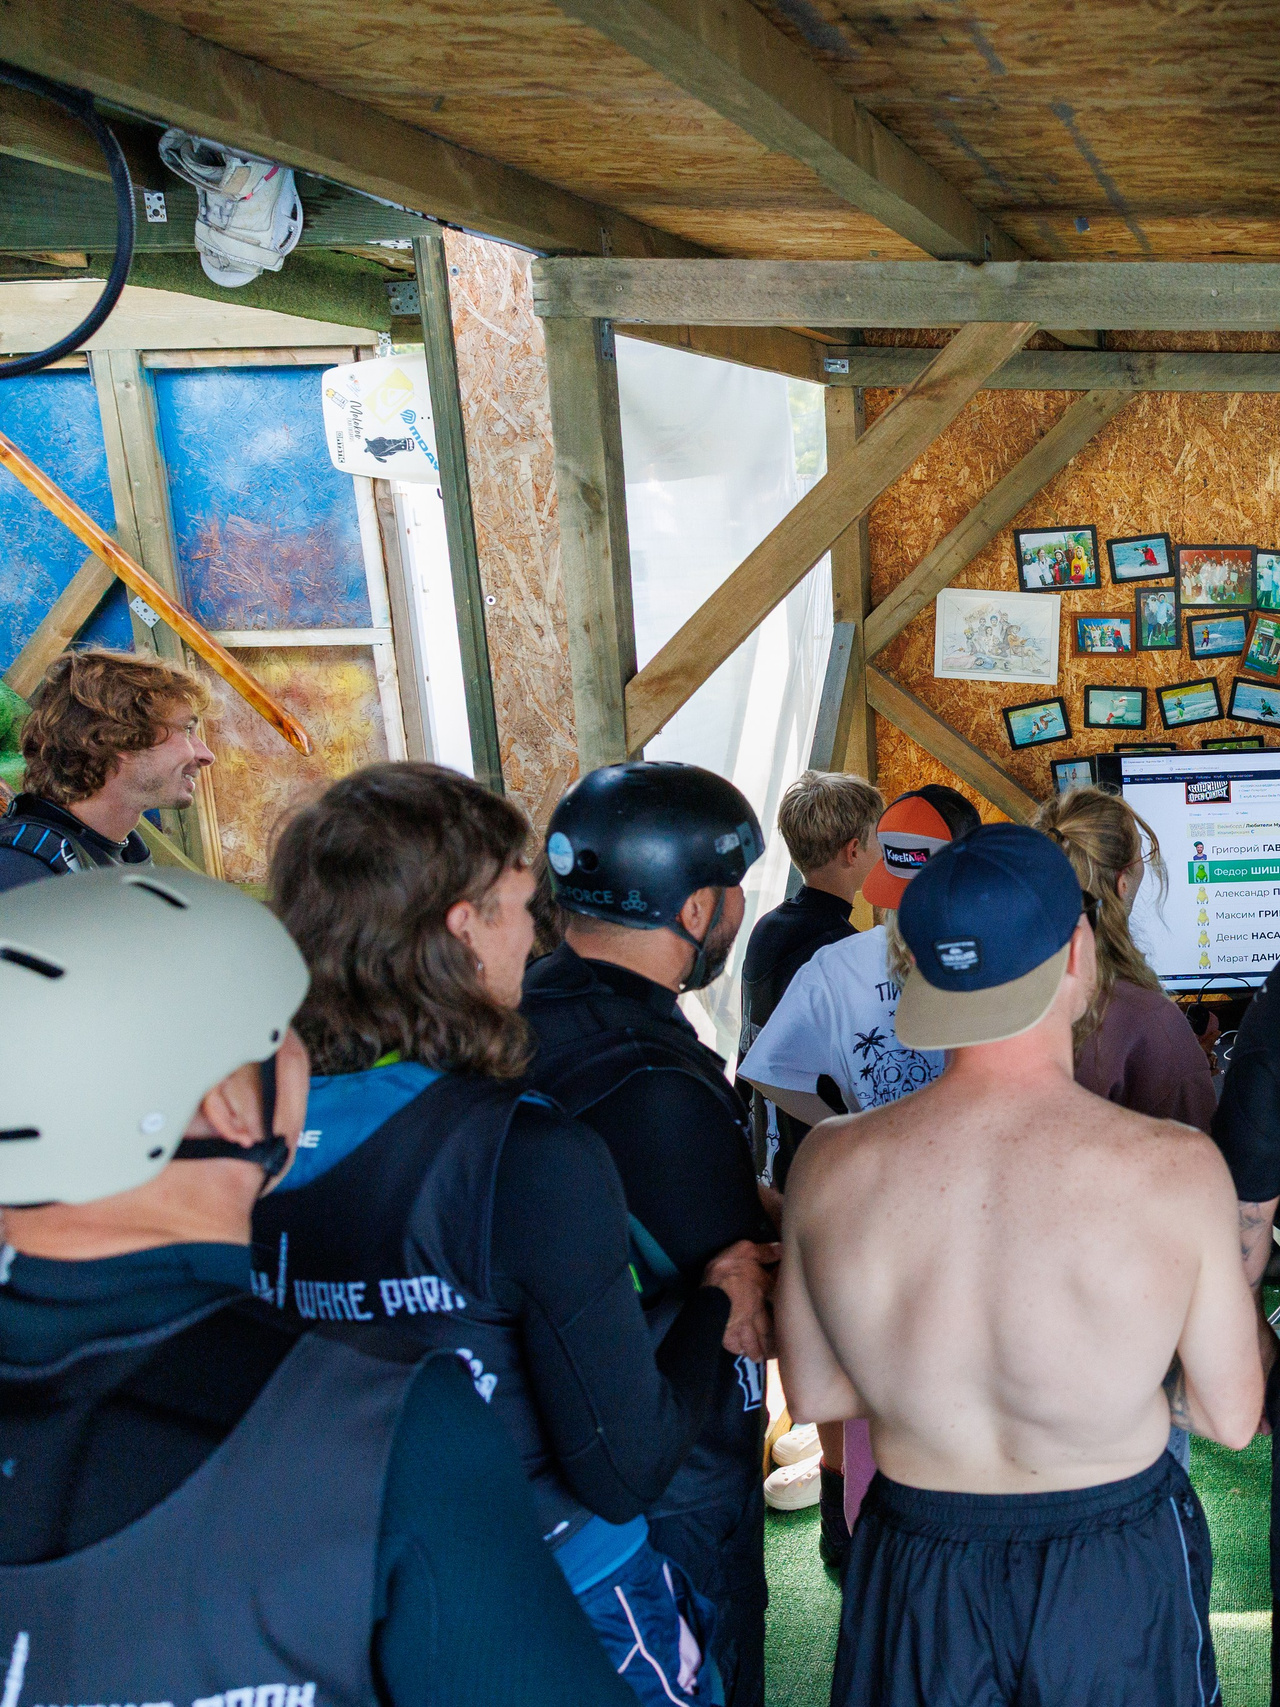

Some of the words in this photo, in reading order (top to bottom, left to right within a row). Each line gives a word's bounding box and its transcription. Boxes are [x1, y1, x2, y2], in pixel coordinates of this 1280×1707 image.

[1211, 843, 1260, 855] Григорий
[1213, 866, 1248, 877] Федор
[1214, 888, 1270, 899] Александр
[1215, 909, 1256, 919] Максим
[1216, 932, 1249, 943] Денис
[1217, 953, 1249, 965] Марат
[293, 1279, 374, 1321] WAKE
